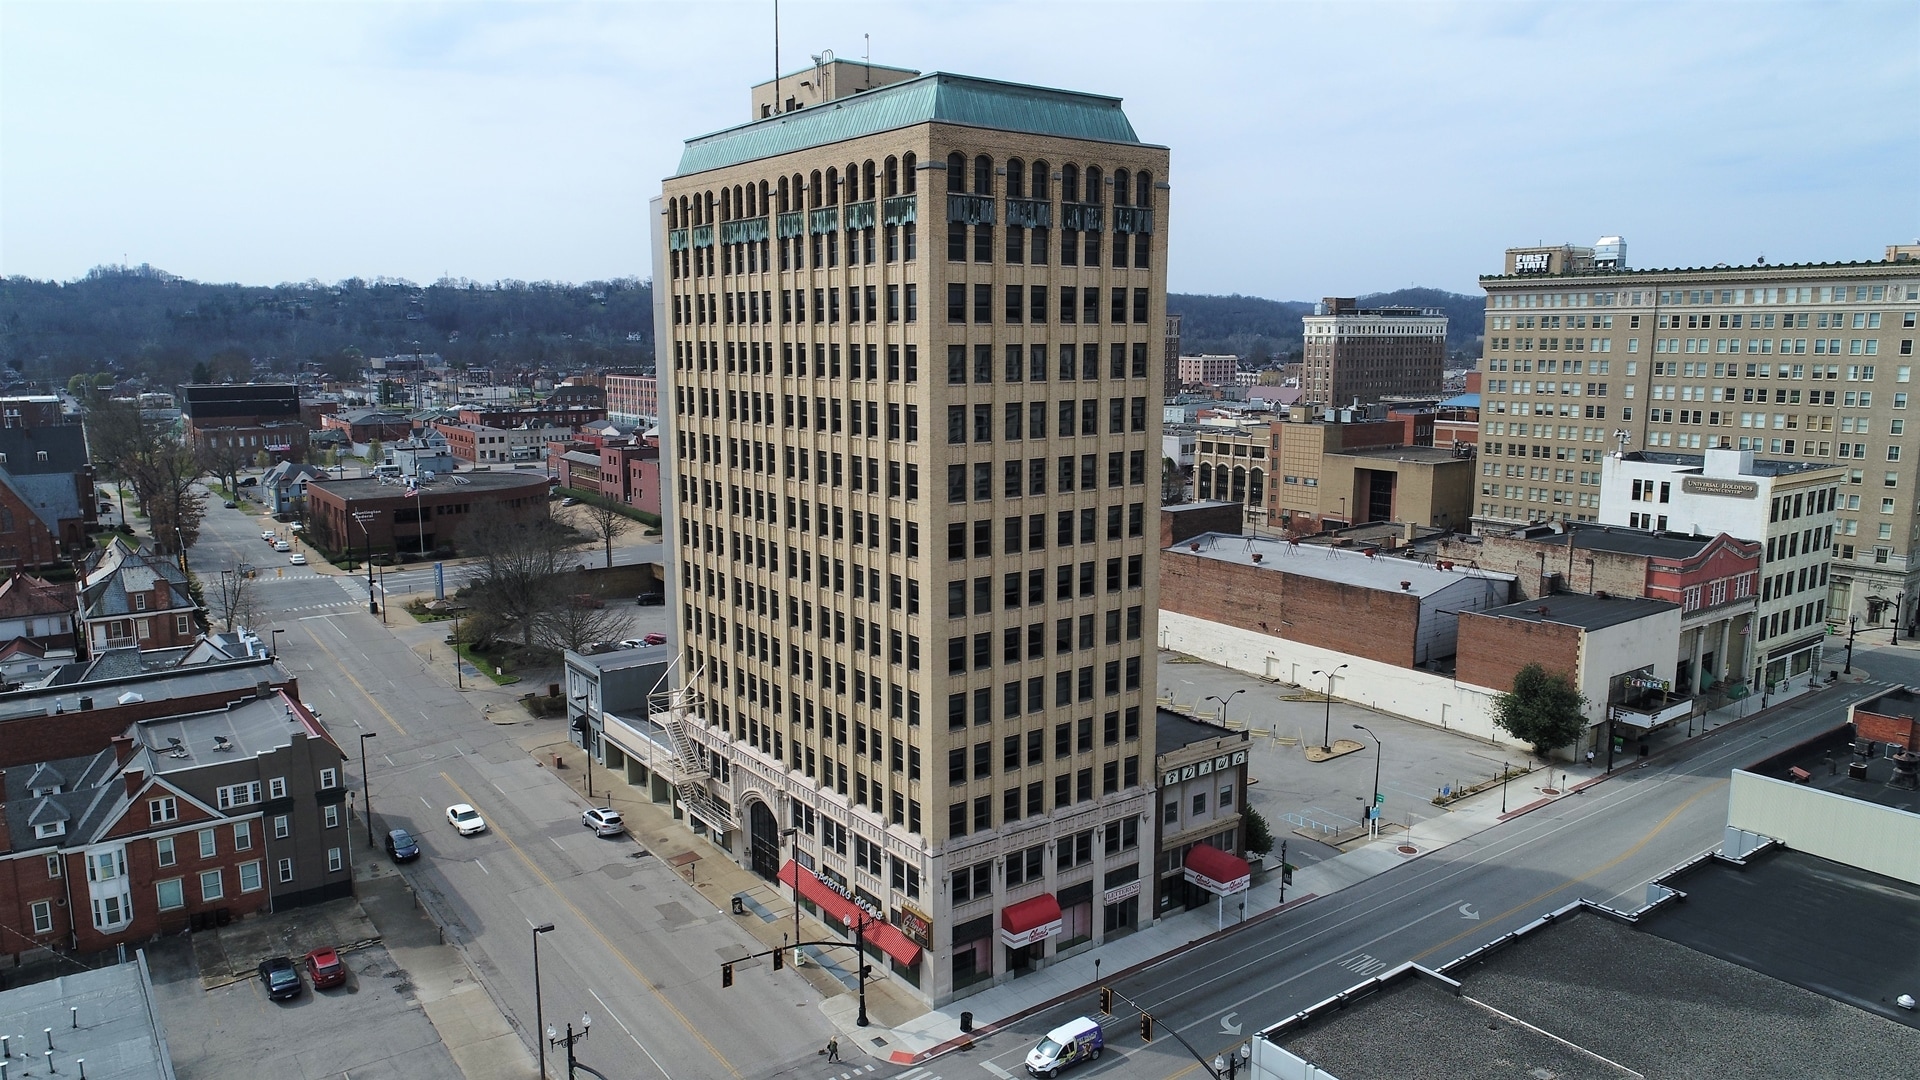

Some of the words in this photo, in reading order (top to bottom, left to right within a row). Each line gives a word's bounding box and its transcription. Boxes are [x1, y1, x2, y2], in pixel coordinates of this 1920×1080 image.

[1516, 254, 1550, 262] FIRST
[1515, 261, 1548, 269] STATE
[1631, 680, 1663, 688] CINEMA
[813, 869, 852, 900] SPORTING
[854, 895, 883, 920] GOOS
[1107, 884, 1139, 899] LETTERING
[1337, 953, 1386, 975] ONLY
